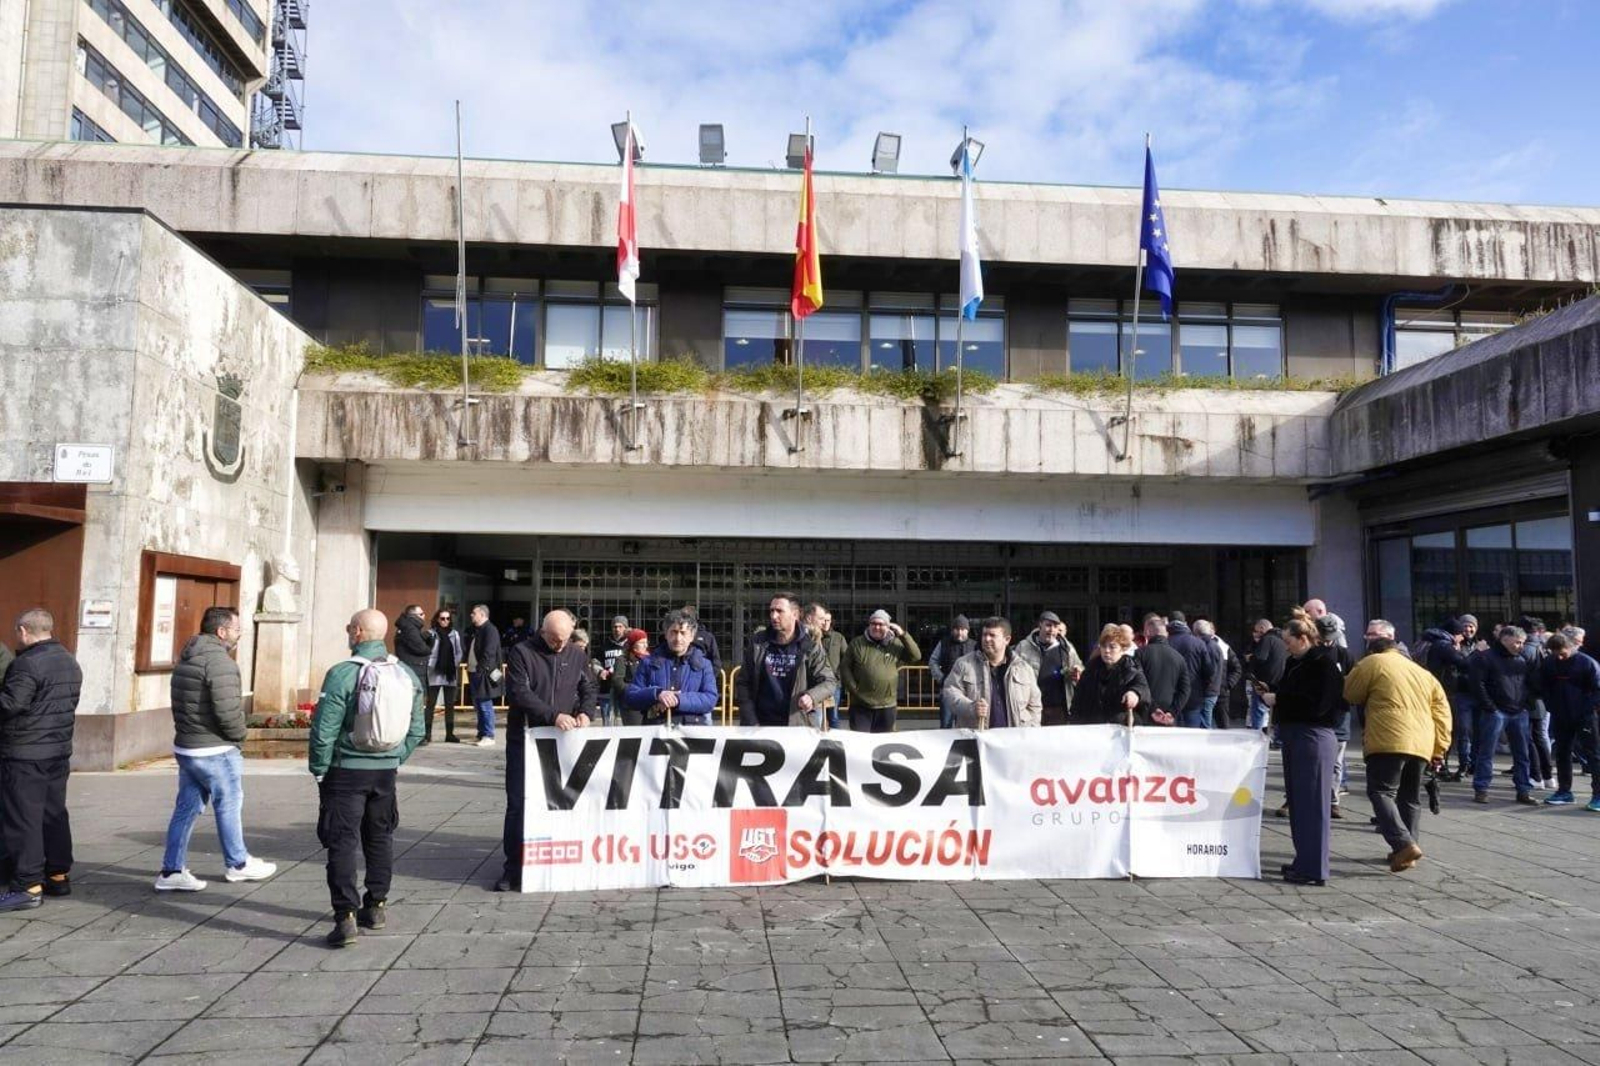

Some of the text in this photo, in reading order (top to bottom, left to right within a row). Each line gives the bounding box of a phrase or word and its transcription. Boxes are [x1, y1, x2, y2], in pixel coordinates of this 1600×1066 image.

[535, 738, 987, 810] VITRASA
[1030, 774, 1197, 806] avanza
[1031, 810, 1121, 826] GRUPO
[592, 834, 641, 863] CIG
[650, 833, 717, 860] USO
[740, 828, 776, 847] UGT
[787, 820, 992, 868] SOLUCIÓN
[1186, 844, 1228, 856] HORARIOS
